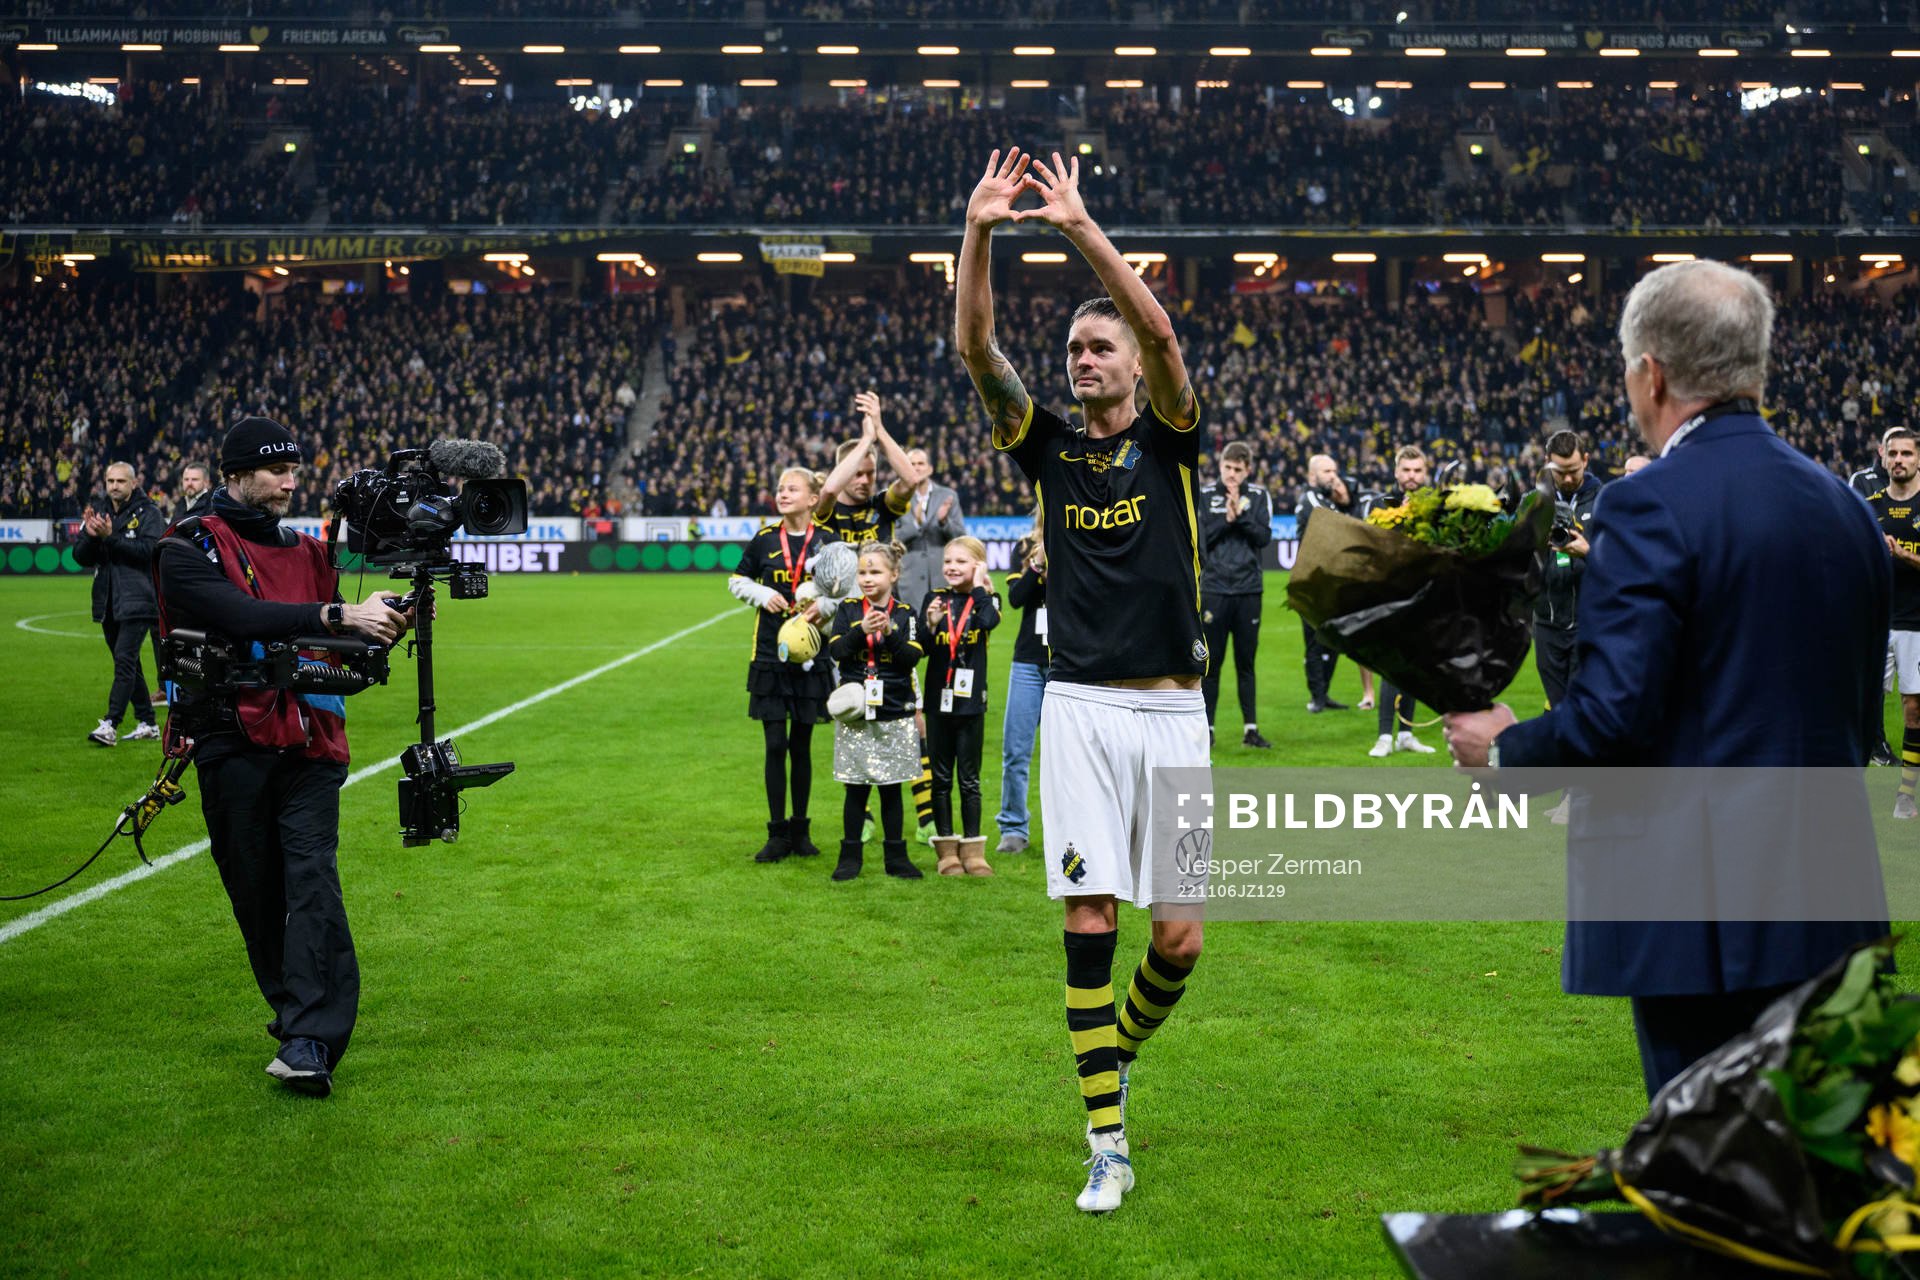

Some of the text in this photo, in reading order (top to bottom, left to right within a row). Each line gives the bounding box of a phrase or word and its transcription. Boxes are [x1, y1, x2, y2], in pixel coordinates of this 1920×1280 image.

[45, 28, 242, 43] TILLSAMMANS MOT MOBBNING
[282, 30, 387, 44] FRIENDS ARENA
[1388, 33, 1577, 48] TILLSAMMANS MOT MOBBNING
[1610, 34, 1712, 48] FRIENDS ARENA
[1064, 495, 1146, 530] notar
